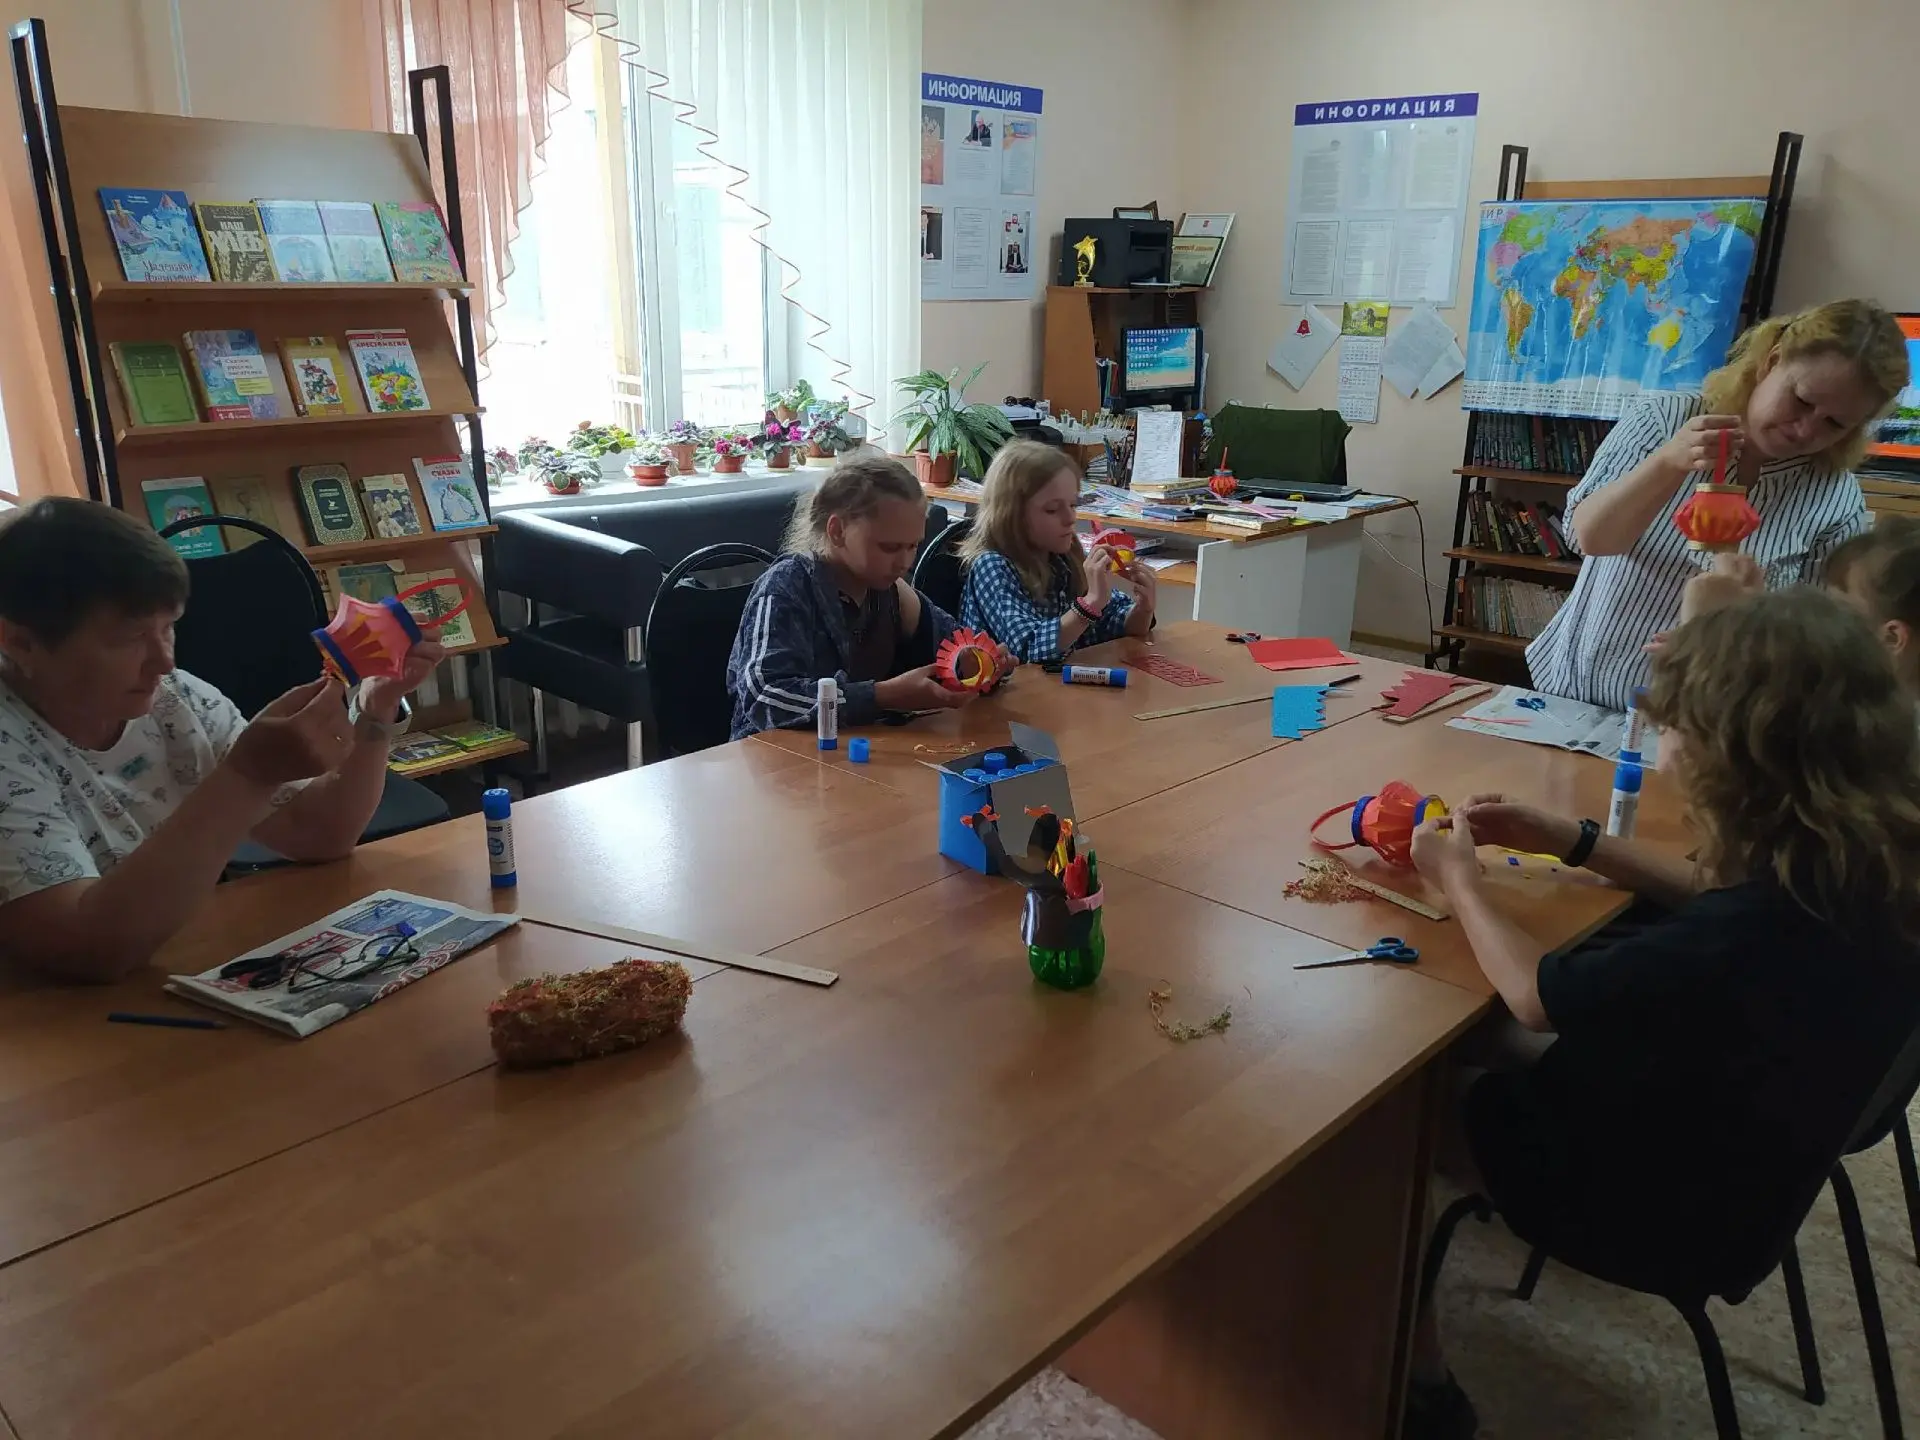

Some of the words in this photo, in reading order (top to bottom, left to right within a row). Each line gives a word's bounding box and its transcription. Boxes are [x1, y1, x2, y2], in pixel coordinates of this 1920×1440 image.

[928, 79, 1022, 107] ИНФОРМАЦИЯ
[1314, 99, 1456, 120] ИНФОРМАЦИЯ
[431, 468, 462, 479] СКАЗКИ
